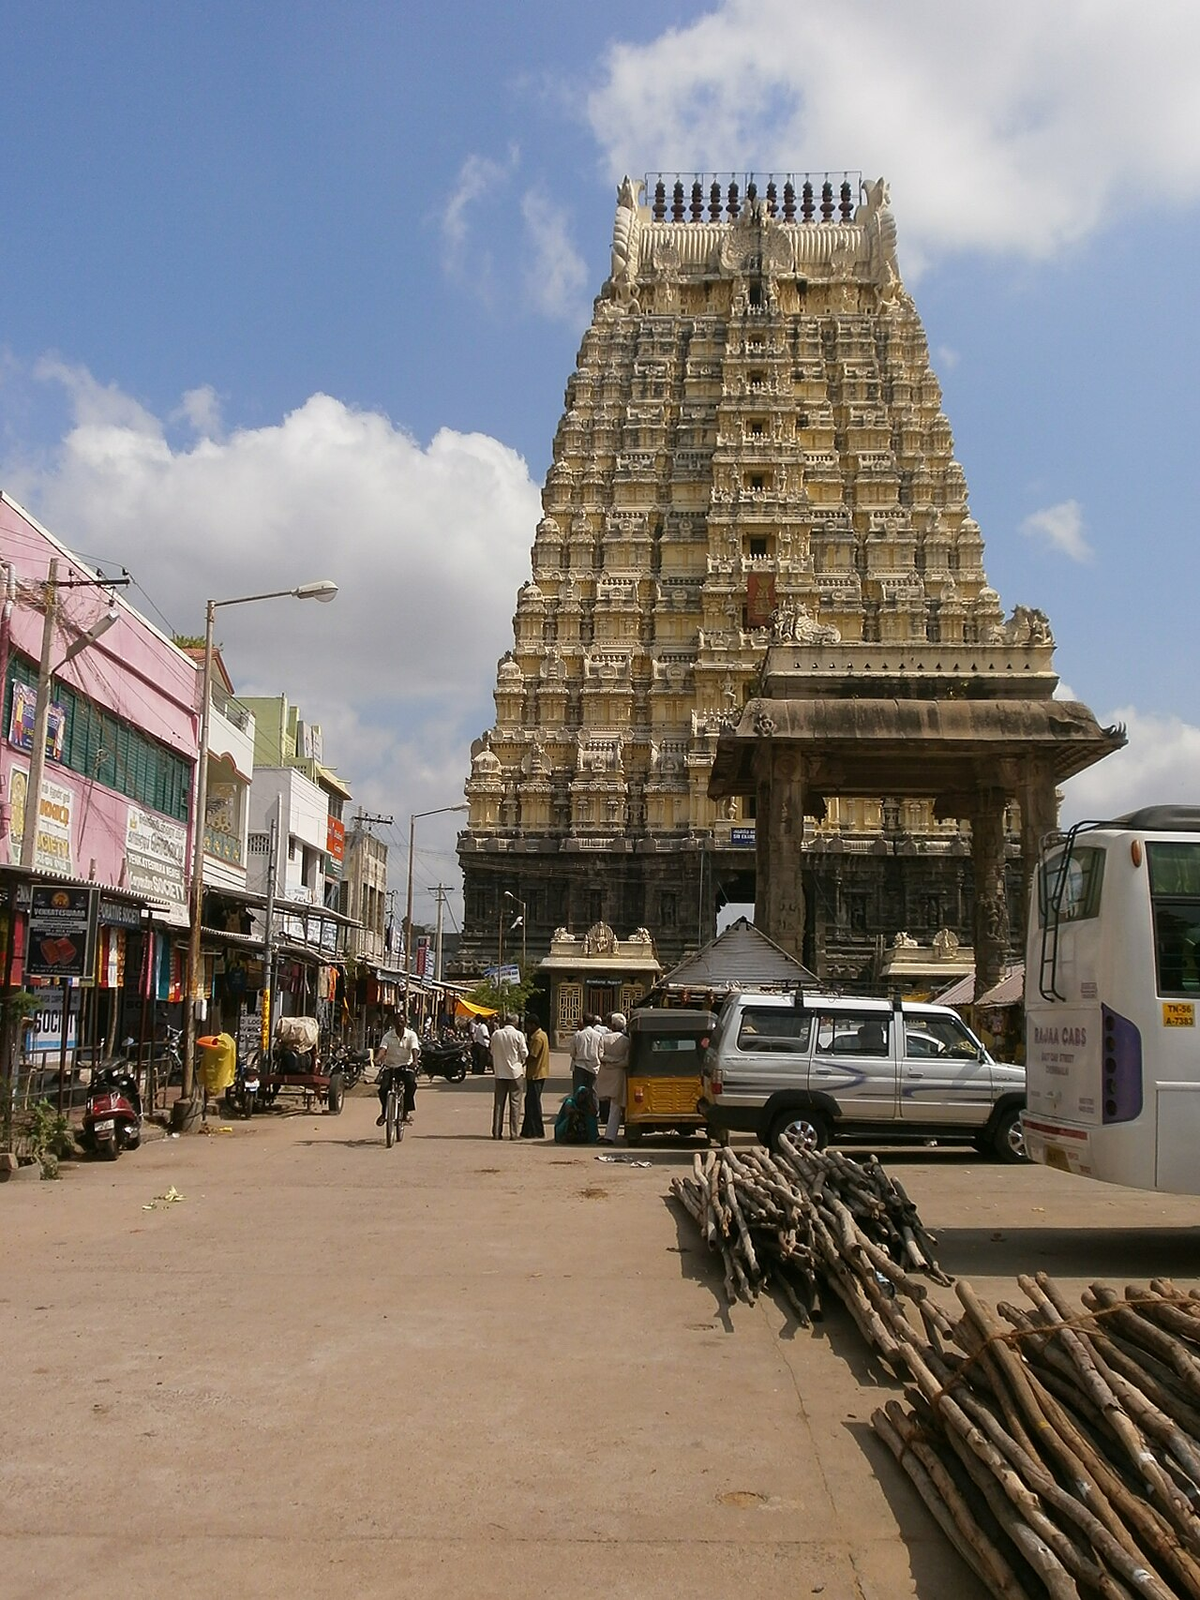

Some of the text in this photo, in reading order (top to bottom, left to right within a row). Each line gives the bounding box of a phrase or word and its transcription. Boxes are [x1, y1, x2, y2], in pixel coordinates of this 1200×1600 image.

[153, 875, 185, 902] SOCIETY
[1168, 1004, 1192, 1013] TN-56
[34, 1009, 77, 1034] SOCITY
[1166, 1017, 1194, 1026] A-7383
[1034, 1027, 1087, 1047] RAJAA CABS
